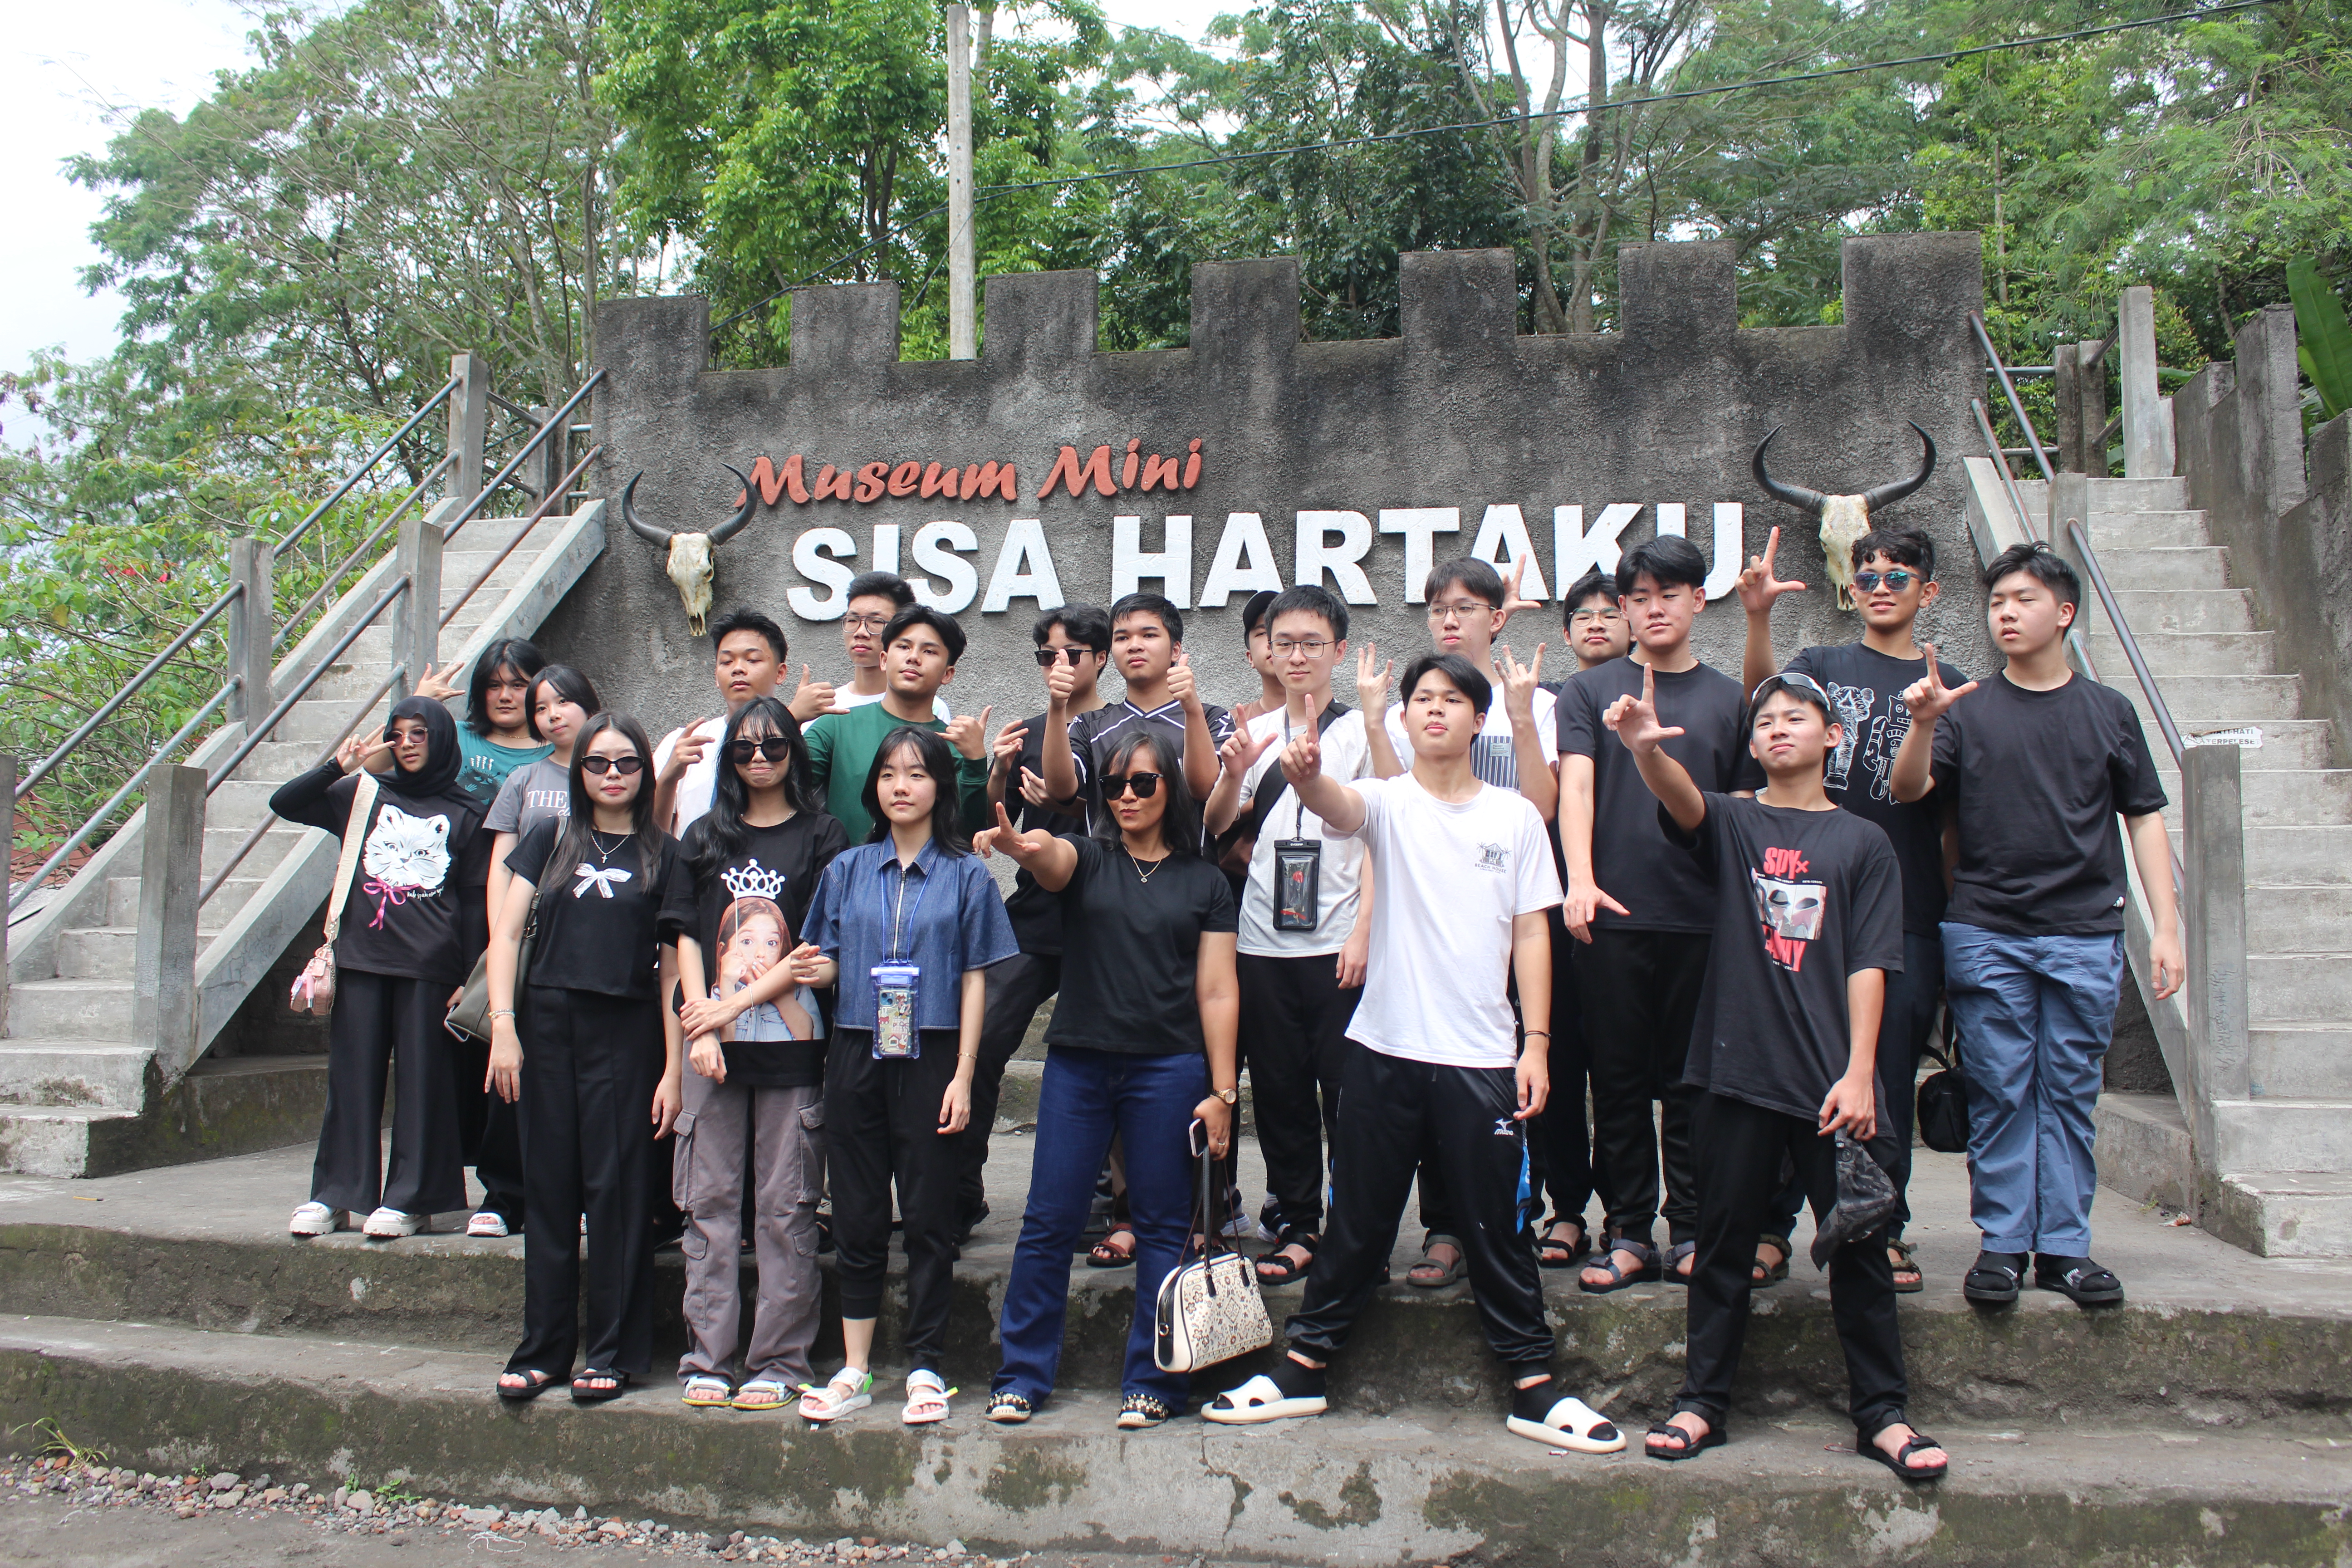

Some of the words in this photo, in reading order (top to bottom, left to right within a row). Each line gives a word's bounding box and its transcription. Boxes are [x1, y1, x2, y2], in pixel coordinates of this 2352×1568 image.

[735, 453, 1017, 507] Museum
[1037, 438, 1202, 500] Mini
[786, 519, 1066, 622] SISA
[1111, 502, 1743, 609] HARTAKU
[527, 789, 568, 808] THE
[1492, 866, 1507, 874] HOUSE
